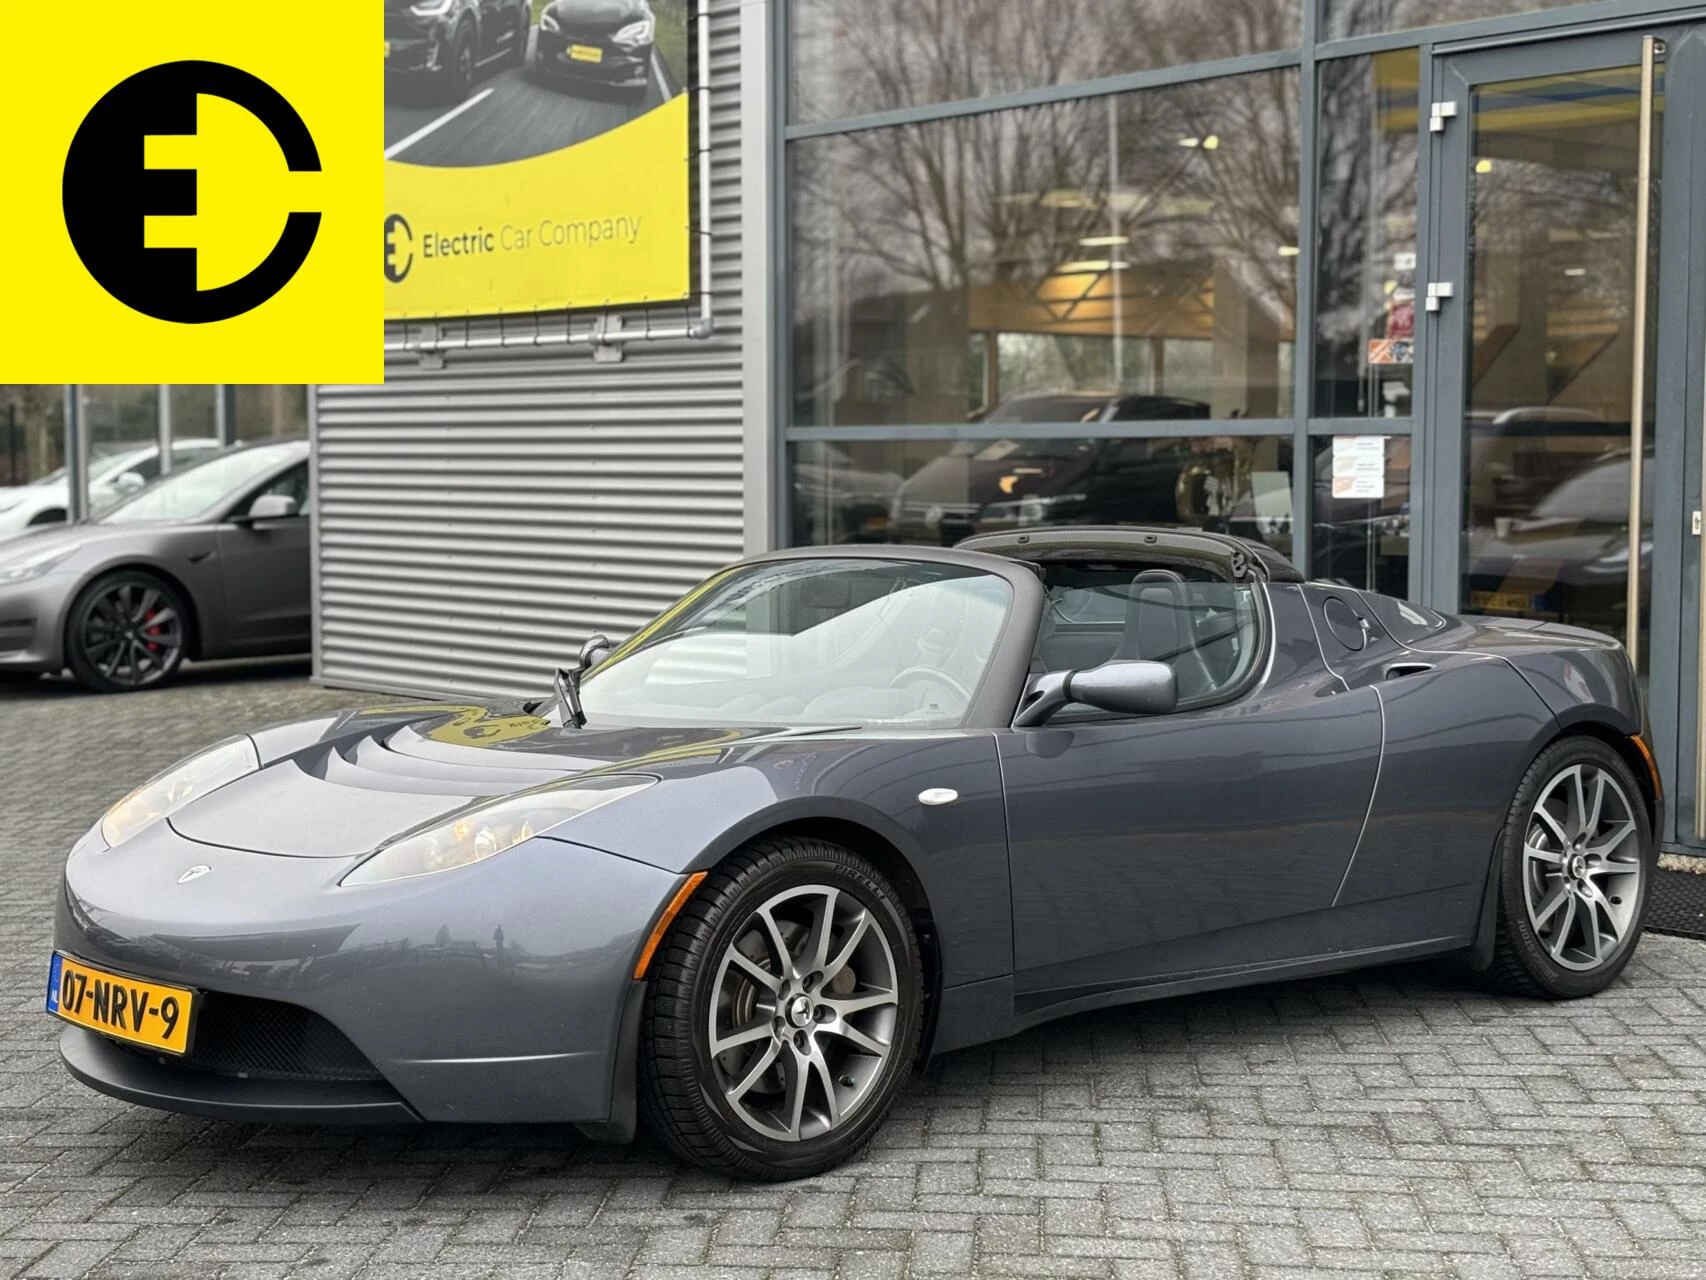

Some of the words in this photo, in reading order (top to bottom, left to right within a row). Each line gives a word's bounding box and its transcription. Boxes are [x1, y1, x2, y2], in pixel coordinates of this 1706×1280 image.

[423, 226, 495, 258] Electric
[500, 224, 533, 251] Car
[538, 215, 642, 246] Company
[834, 864, 886, 899] PIRELLI
[62, 969, 180, 1040] 07-NRV-9
